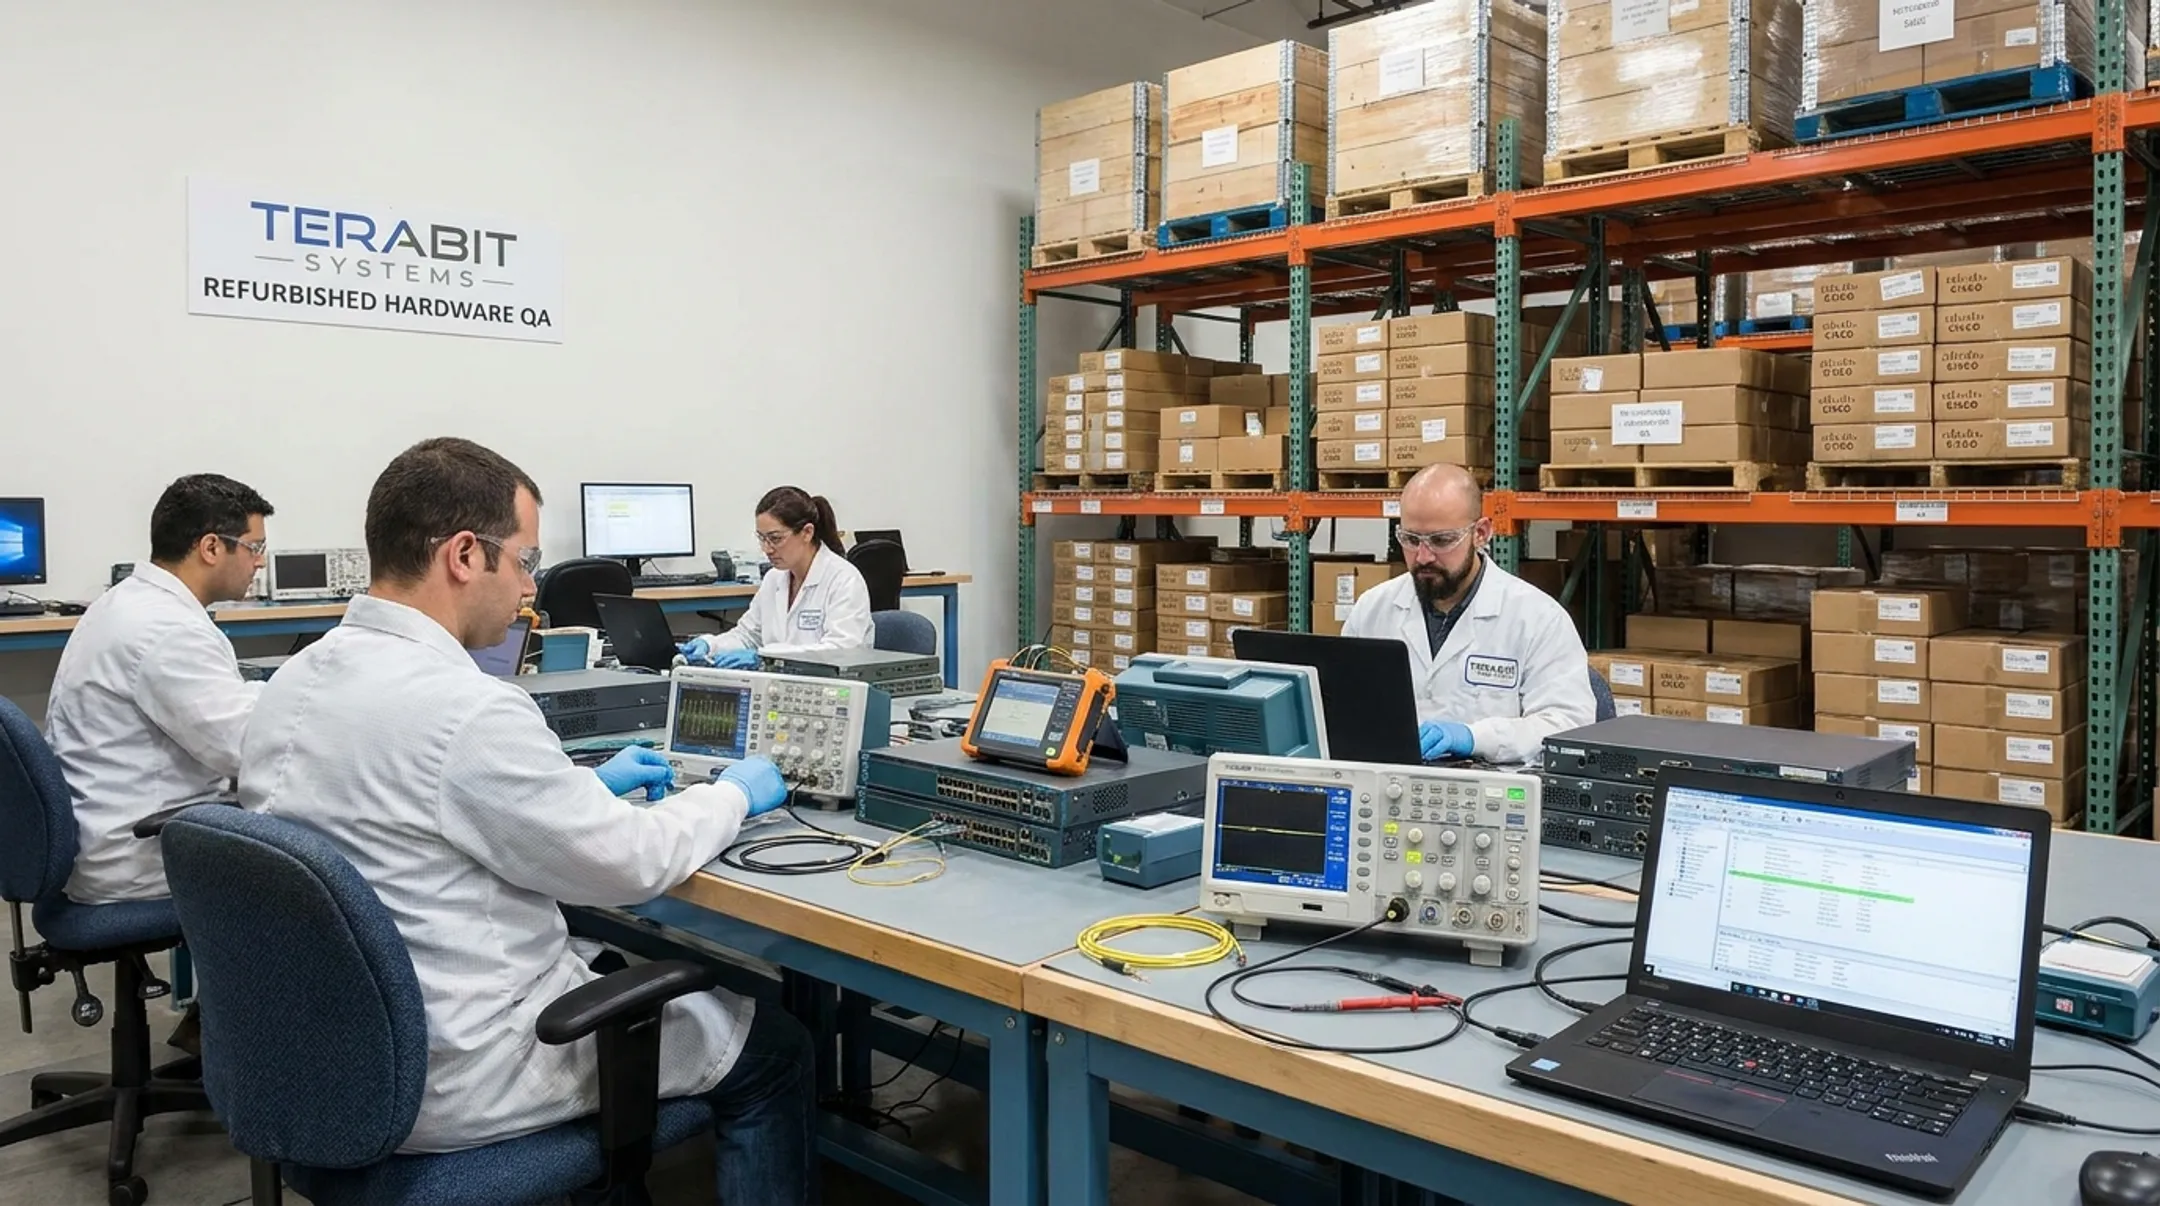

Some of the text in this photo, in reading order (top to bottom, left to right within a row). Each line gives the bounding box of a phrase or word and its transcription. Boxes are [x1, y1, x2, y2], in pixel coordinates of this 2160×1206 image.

[250, 201, 518, 267] TERABIT
[305, 253, 474, 288] SYSTEMS
[203, 276, 552, 328] REFURBISHED HARDWARE QA
